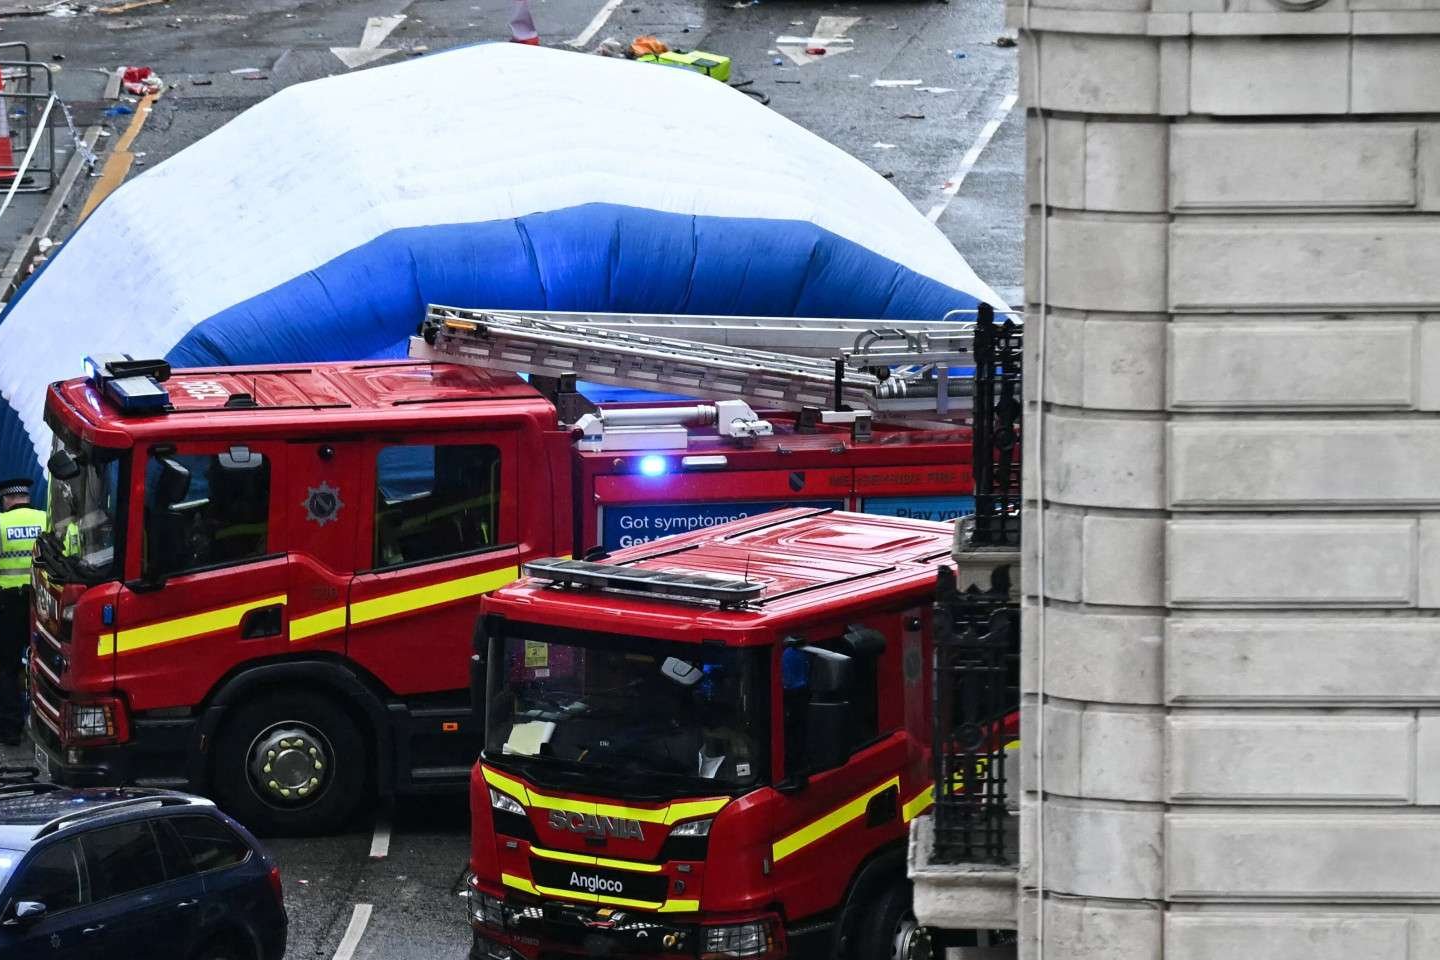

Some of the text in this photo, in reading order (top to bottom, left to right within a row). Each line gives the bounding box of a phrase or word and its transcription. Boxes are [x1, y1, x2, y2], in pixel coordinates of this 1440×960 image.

[620, 512, 748, 531] Got symptoms?
[7, 526, 41, 539] POLICE
[549, 808, 644, 841] SCANIA
[570, 871, 623, 892] Angloco
